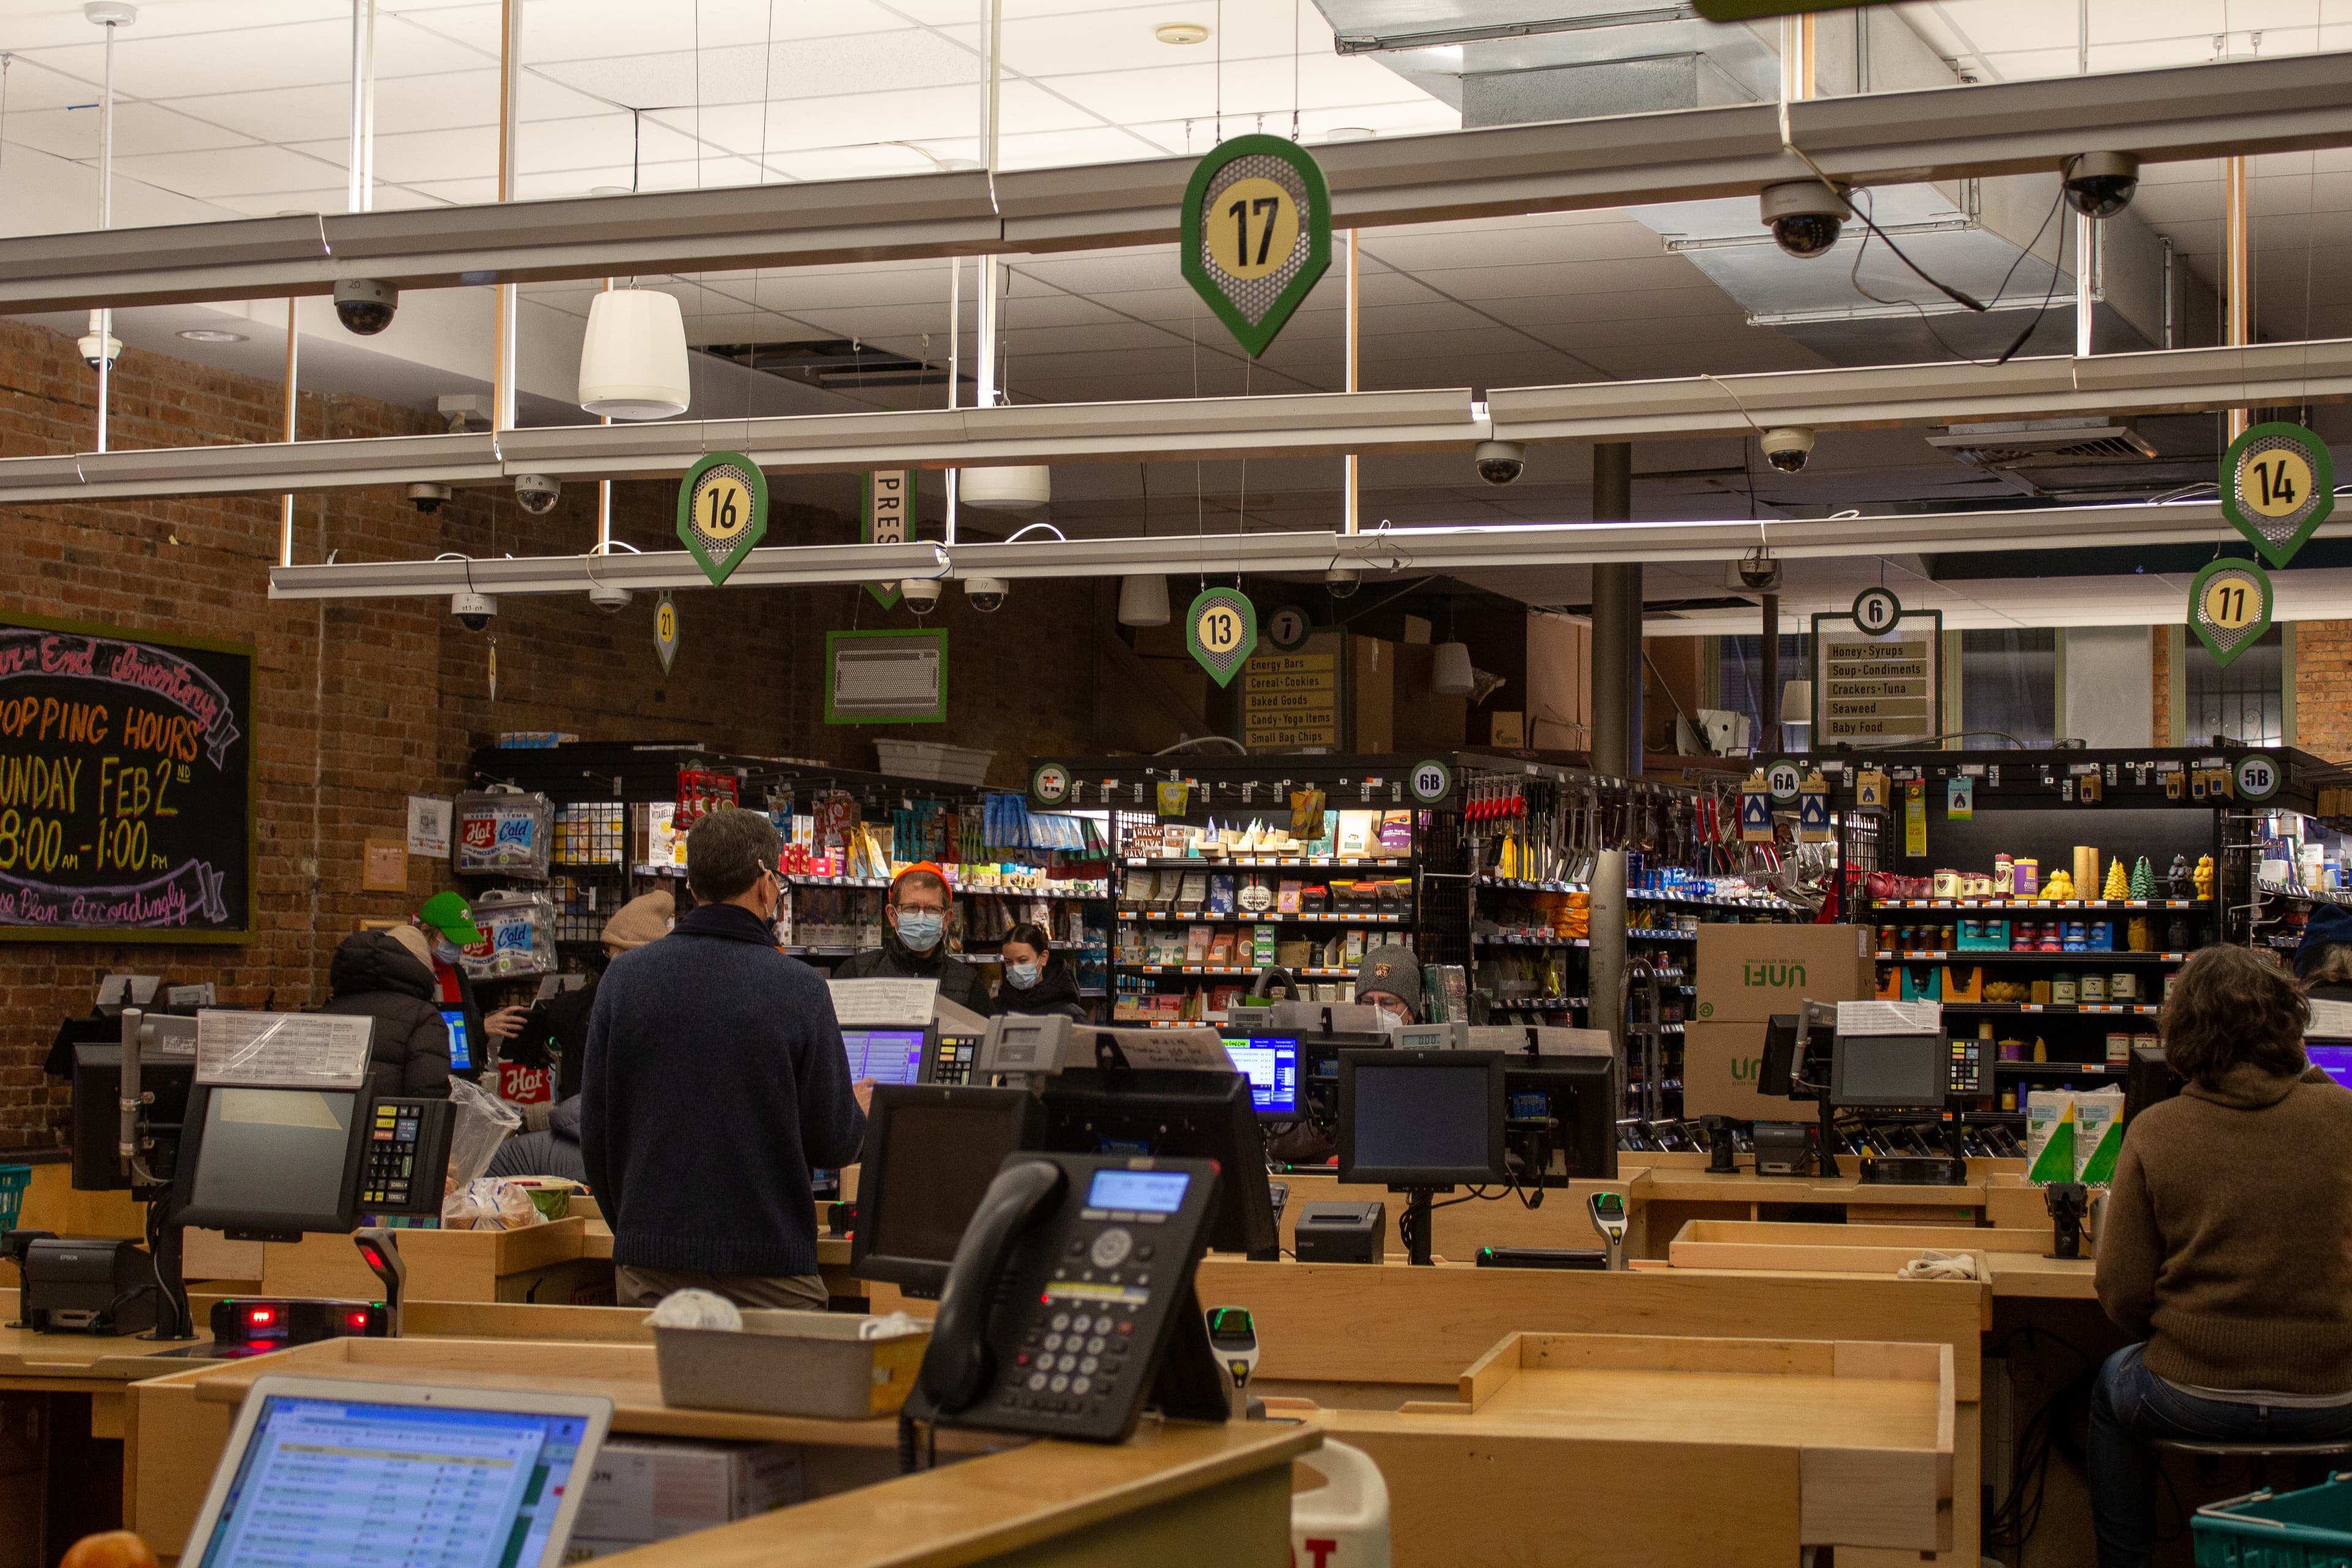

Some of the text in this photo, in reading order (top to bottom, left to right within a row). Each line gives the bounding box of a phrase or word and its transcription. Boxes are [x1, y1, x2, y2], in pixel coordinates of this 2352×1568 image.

[1229, 197, 1278, 266] 17
[2253, 460, 2296, 506] 14
[708, 488, 736, 529] 16
[1869, 599, 1883, 623] 6
[2220, 587, 2245, 622] 11
[662, 614, 671, 636] 21
[1207, 614, 1231, 645] 13
[1282, 617, 1292, 639] 7
[1833, 646, 1903, 658] Honey Syrups
[1251, 658, 1304, 671] Energy Bars
[1833, 664, 1921, 677] Soup Condiments
[112, 647, 216, 732] Inventory
[1251, 677, 1319, 688] Cereal Cookies
[1833, 683, 1905, 695] Crackers Tuna
[1251, 696, 1307, 706] Baked Goods
[1833, 703, 1876, 713] Seaweed
[1252, 714, 1330, 728] Candy Yoga Items
[1833, 722, 1882, 734] Baby Food
[124, 707, 198, 762] HOURS
[1251, 732, 1322, 744] Small Bag Chips
[100, 757, 151, 818] FEB
[1420, 774, 1439, 790] 6B
[1774, 774, 1795, 790] 6A
[2245, 769, 2268, 786] 5B
[0, 809, 62, 872] 8:00
[62, 854, 78, 870] AM
[97, 816, 148, 872] 1:00
[151, 854, 168, 870] PM
[467, 821, 529, 843] Hot Cold
[20, 888, 58, 922] Plan
[72, 880, 186, 926] Accordingly
[498, 925, 526, 948] Cold
[1744, 965, 1806, 989] UNFI
[507, 1067, 543, 1096] Hot
